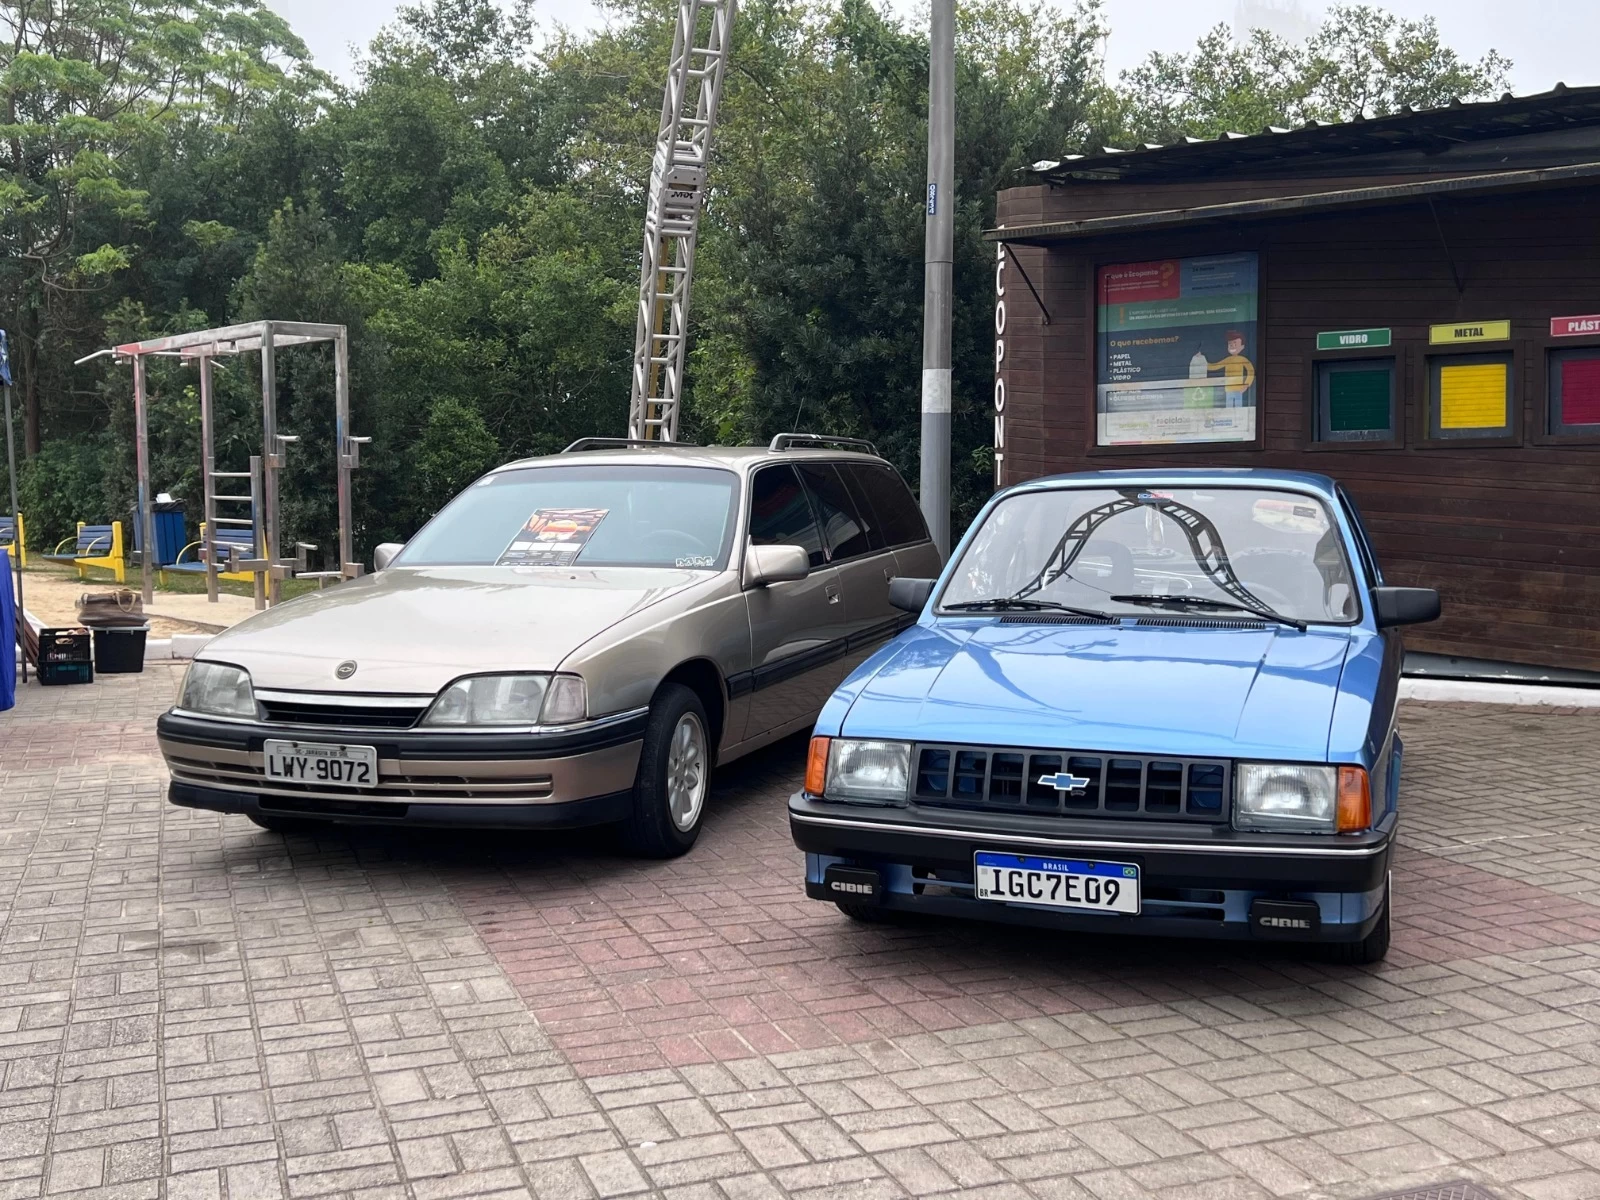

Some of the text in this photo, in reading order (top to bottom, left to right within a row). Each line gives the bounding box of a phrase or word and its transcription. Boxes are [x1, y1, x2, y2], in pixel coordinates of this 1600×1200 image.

[1454, 327, 1484, 338] METAL
[1117, 340, 1132, 348] que
[1132, 336, 1179, 346] recebemos?
[1339, 334, 1368, 345] VIDRO
[1043, 862, 1069, 872] BRASIL
[990, 869, 1120, 906] IGC7E09
[979, 889, 989, 898] BR
